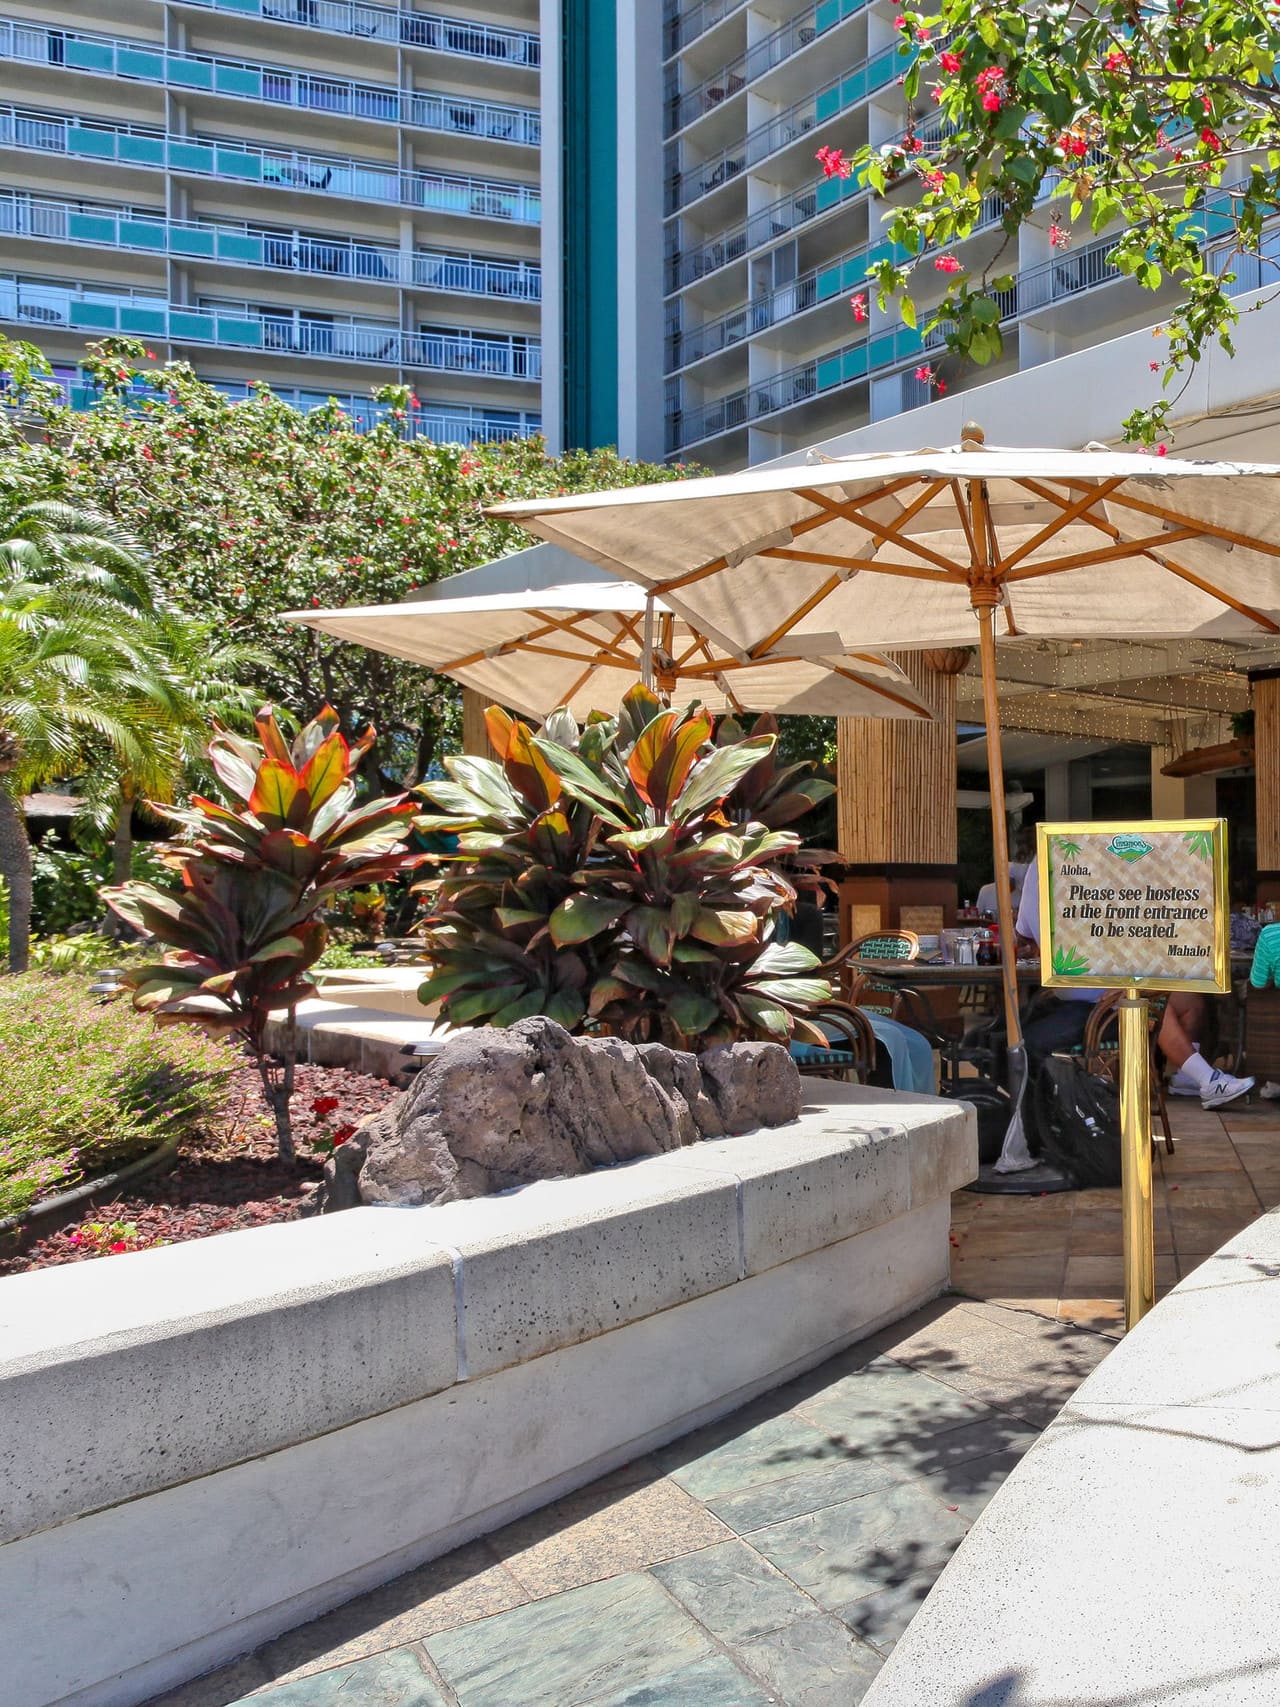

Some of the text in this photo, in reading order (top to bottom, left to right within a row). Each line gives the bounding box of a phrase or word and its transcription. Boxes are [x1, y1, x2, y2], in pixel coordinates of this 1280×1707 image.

[1060, 864, 1091, 877] Aloha,
[1069, 885, 1199, 901] Please see hostess
[1062, 904, 1208, 920] at the front entrance
[1090, 922, 1178, 938] to be seated.
[1167, 945, 1211, 957] Mahalo!
